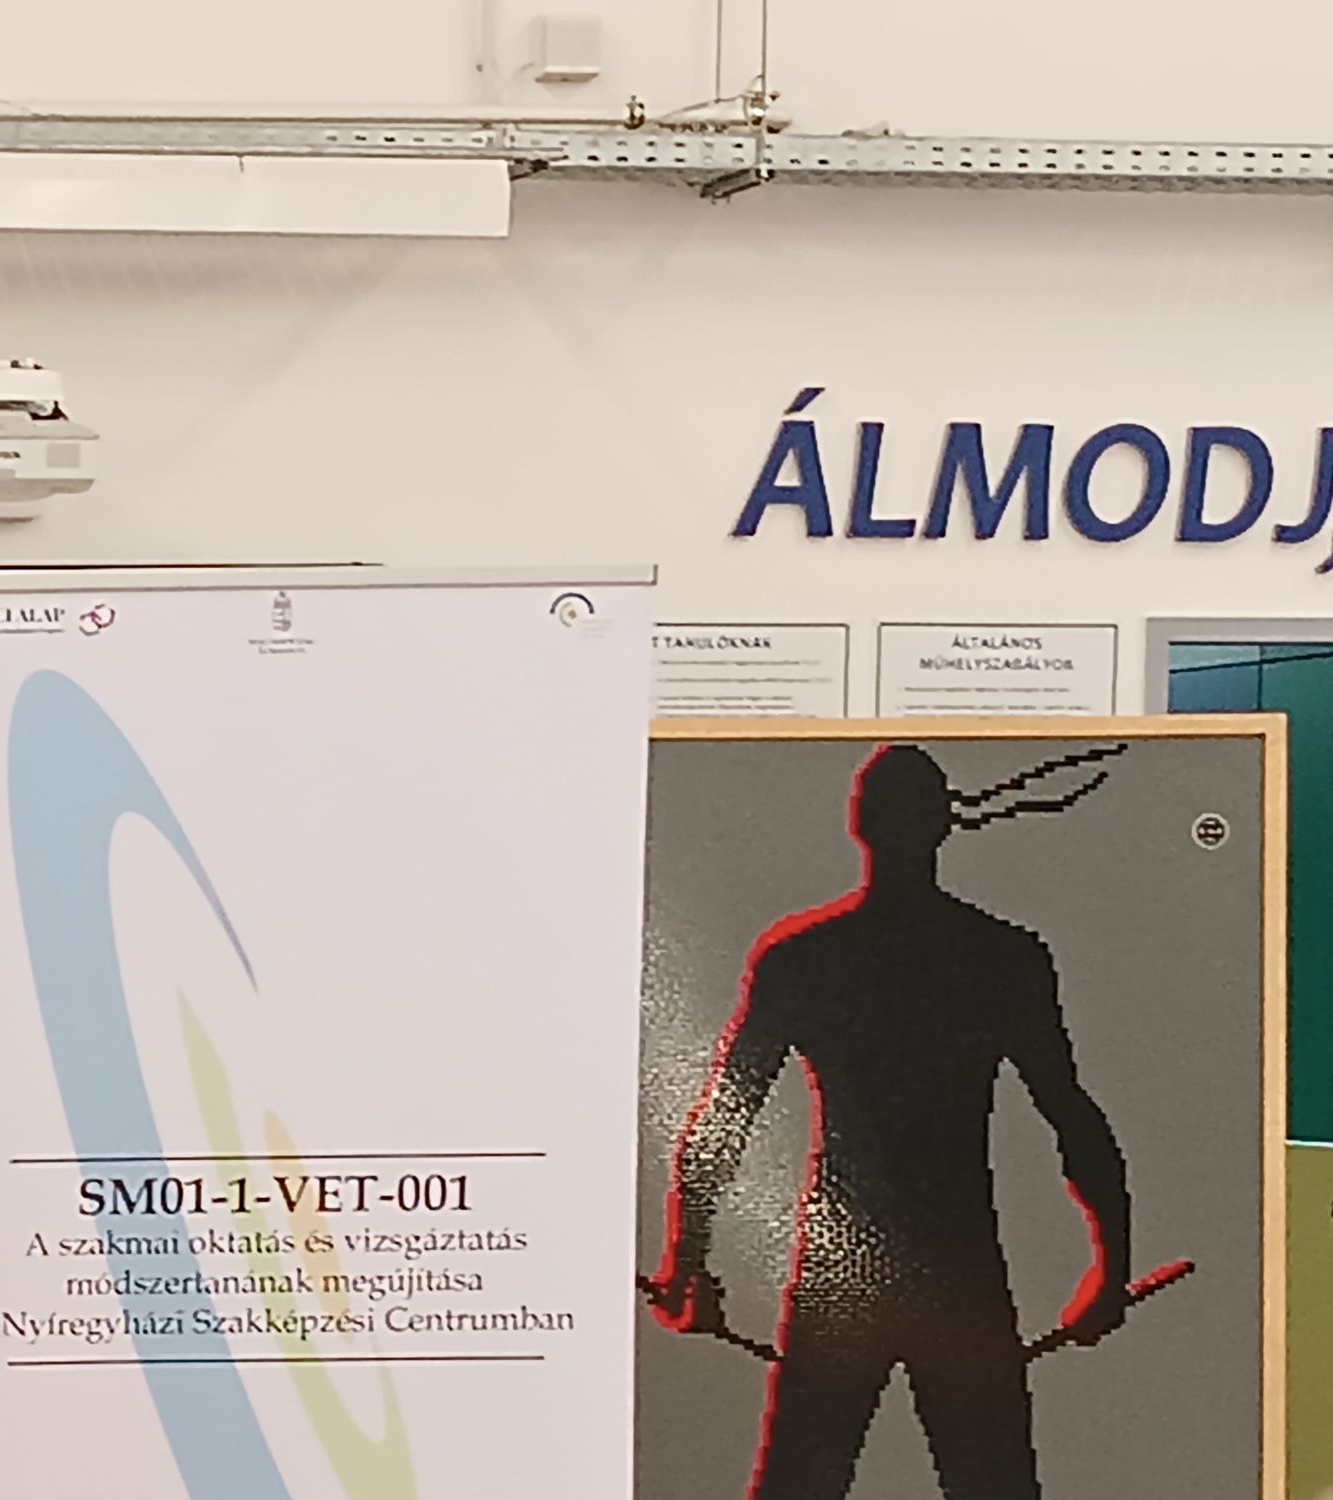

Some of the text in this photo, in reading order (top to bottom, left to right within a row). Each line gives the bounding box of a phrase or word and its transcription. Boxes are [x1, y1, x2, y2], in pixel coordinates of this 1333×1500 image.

[78, 1173, 473, 1217] SM01-1-VET-001
[25, 1227, 528, 1261] A szakmai oktatás és vizsgáztatás
[66, 1267, 484, 1300] módszertanának megújítása
[1, 1308, 185, 1345] Nyíregyházi
[191, 1307, 375, 1341] Szakképzési
[384, 1304, 575, 1334] Centrumban
